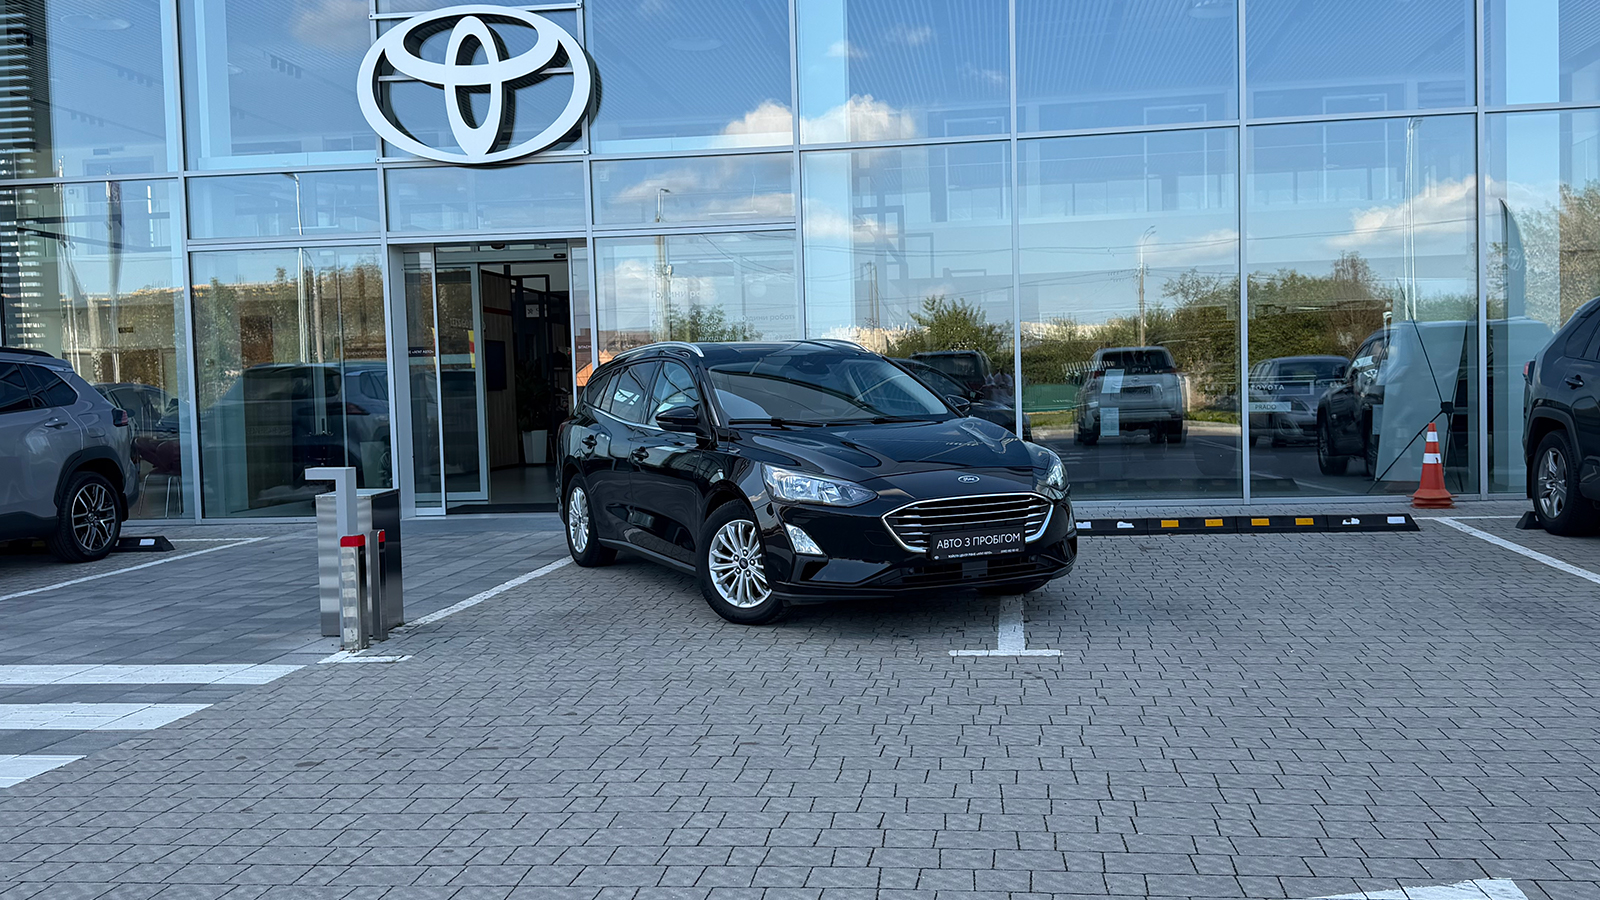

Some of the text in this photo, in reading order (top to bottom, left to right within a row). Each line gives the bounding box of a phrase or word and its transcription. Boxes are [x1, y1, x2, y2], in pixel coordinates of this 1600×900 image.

[1254, 403, 1277, 411] PRADO
[936, 538, 963, 550] АВТО
[972, 532, 1021, 546] ПРОБІГОМ
